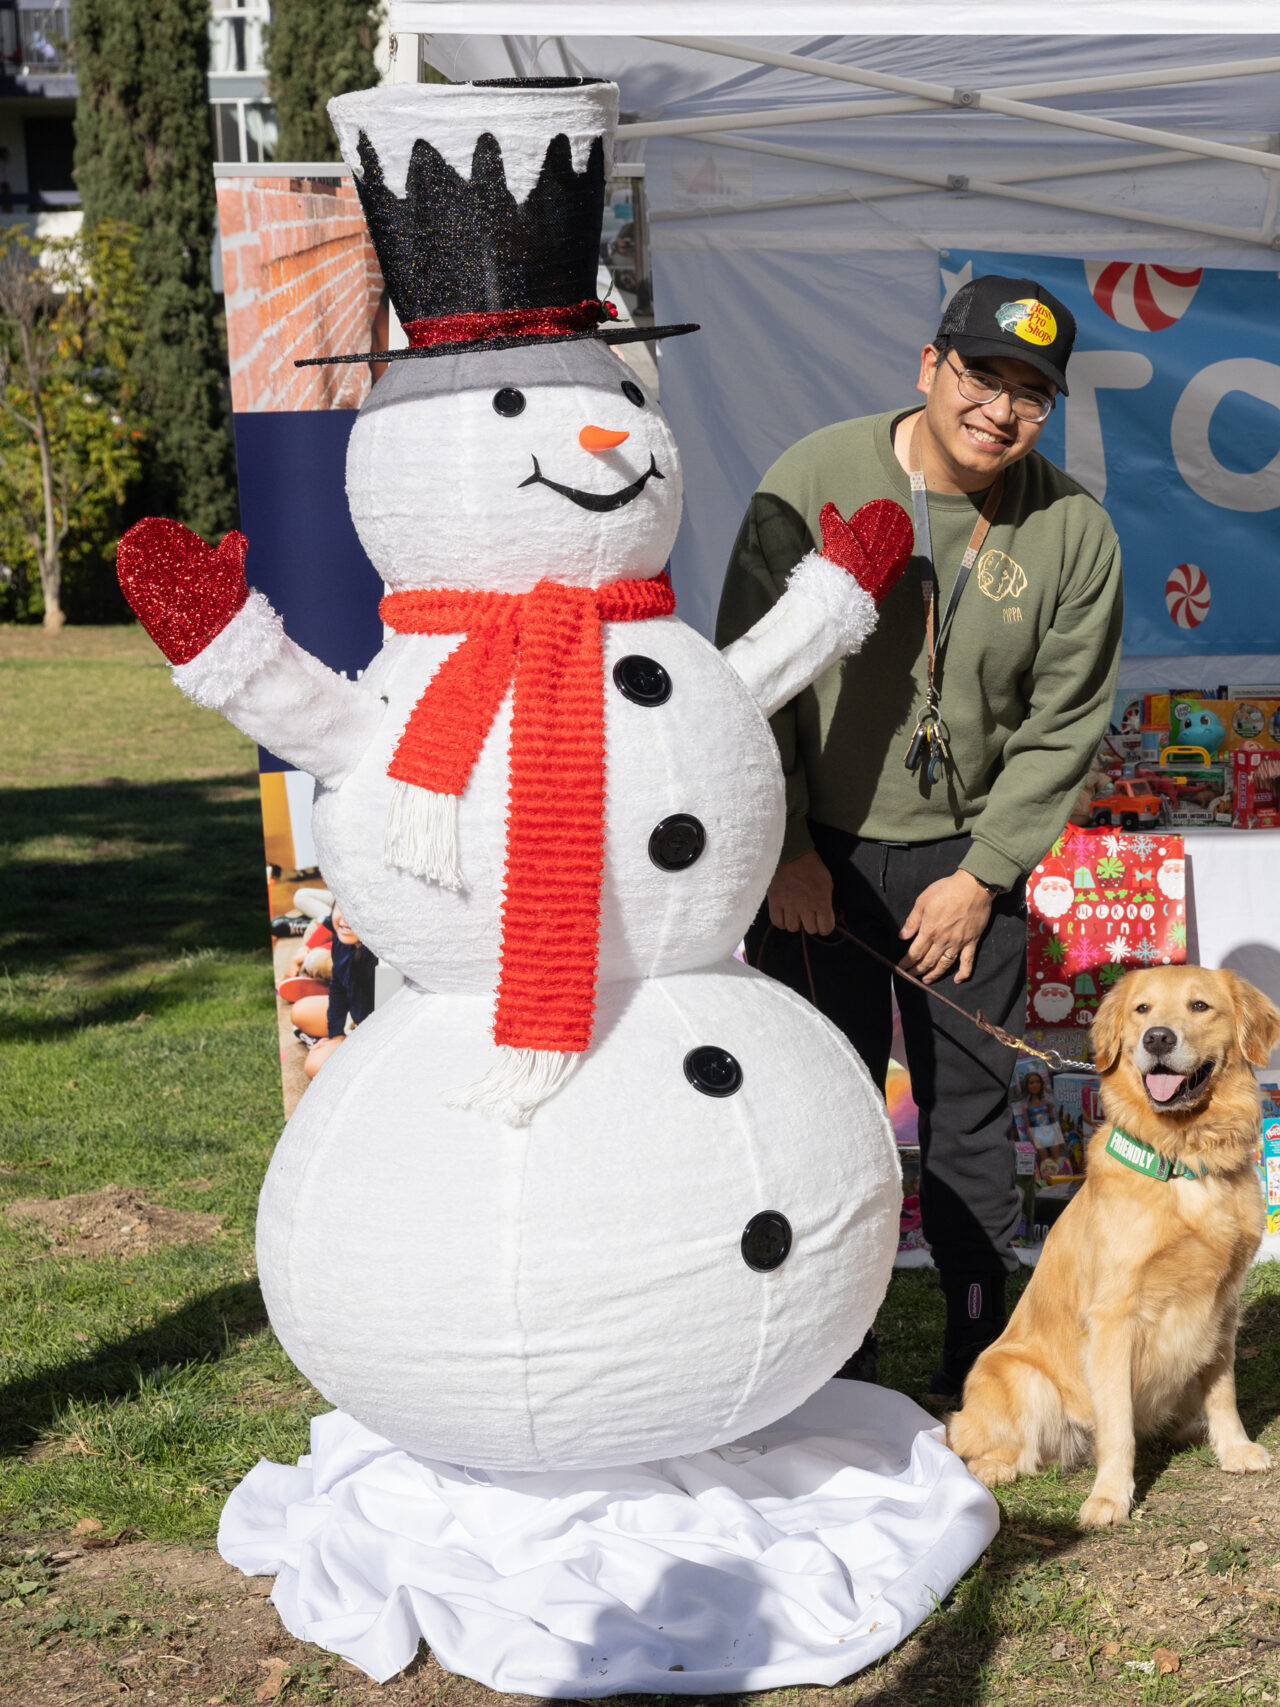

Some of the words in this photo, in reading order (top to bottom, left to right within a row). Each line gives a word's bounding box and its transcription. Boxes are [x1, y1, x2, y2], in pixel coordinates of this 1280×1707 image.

[1029, 312, 1046, 327] Pro
[1030, 301, 1051, 320] Bass
[1025, 322, 1052, 343] Shops
[1002, 607, 1023, 623] PIPPA
[1110, 1131, 1155, 1170] FRIENDLY
